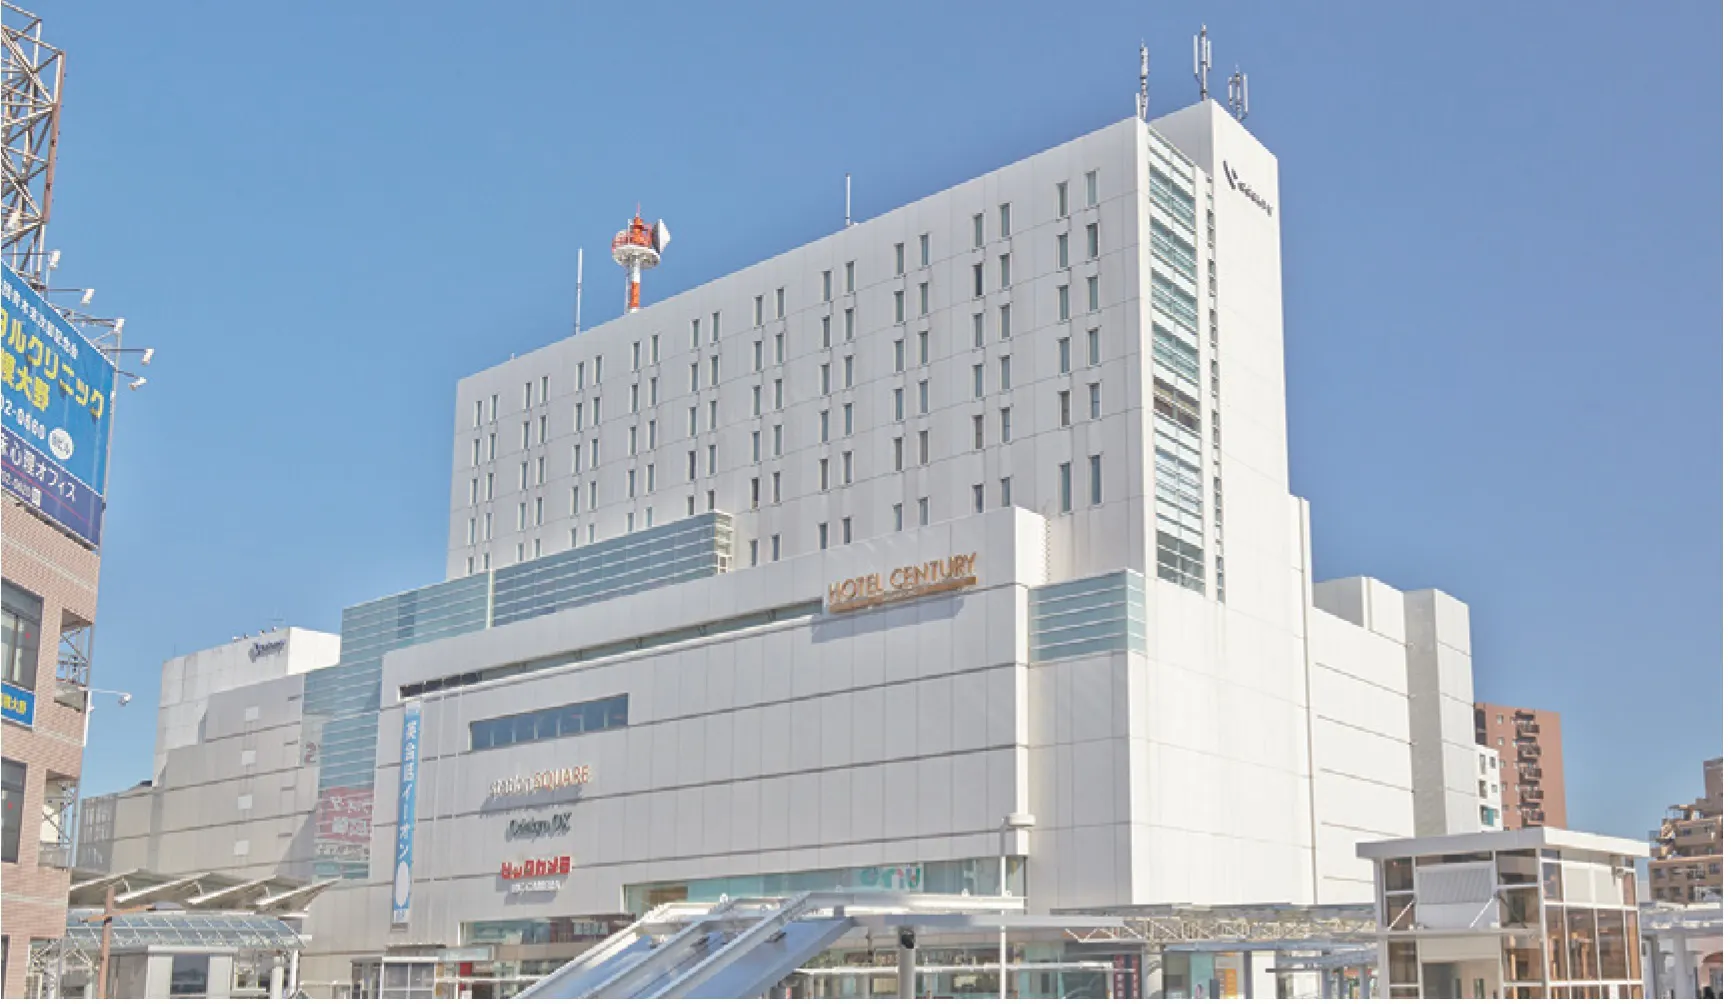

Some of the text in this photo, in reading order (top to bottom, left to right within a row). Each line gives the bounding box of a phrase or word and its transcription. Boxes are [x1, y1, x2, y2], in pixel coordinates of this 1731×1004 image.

[828, 572, 884, 606] HOTEL
[890, 553, 976, 589] CENTURY
[533, 765, 590, 792] SQUARE
[501, 856, 572, 880] ビックカメラ
